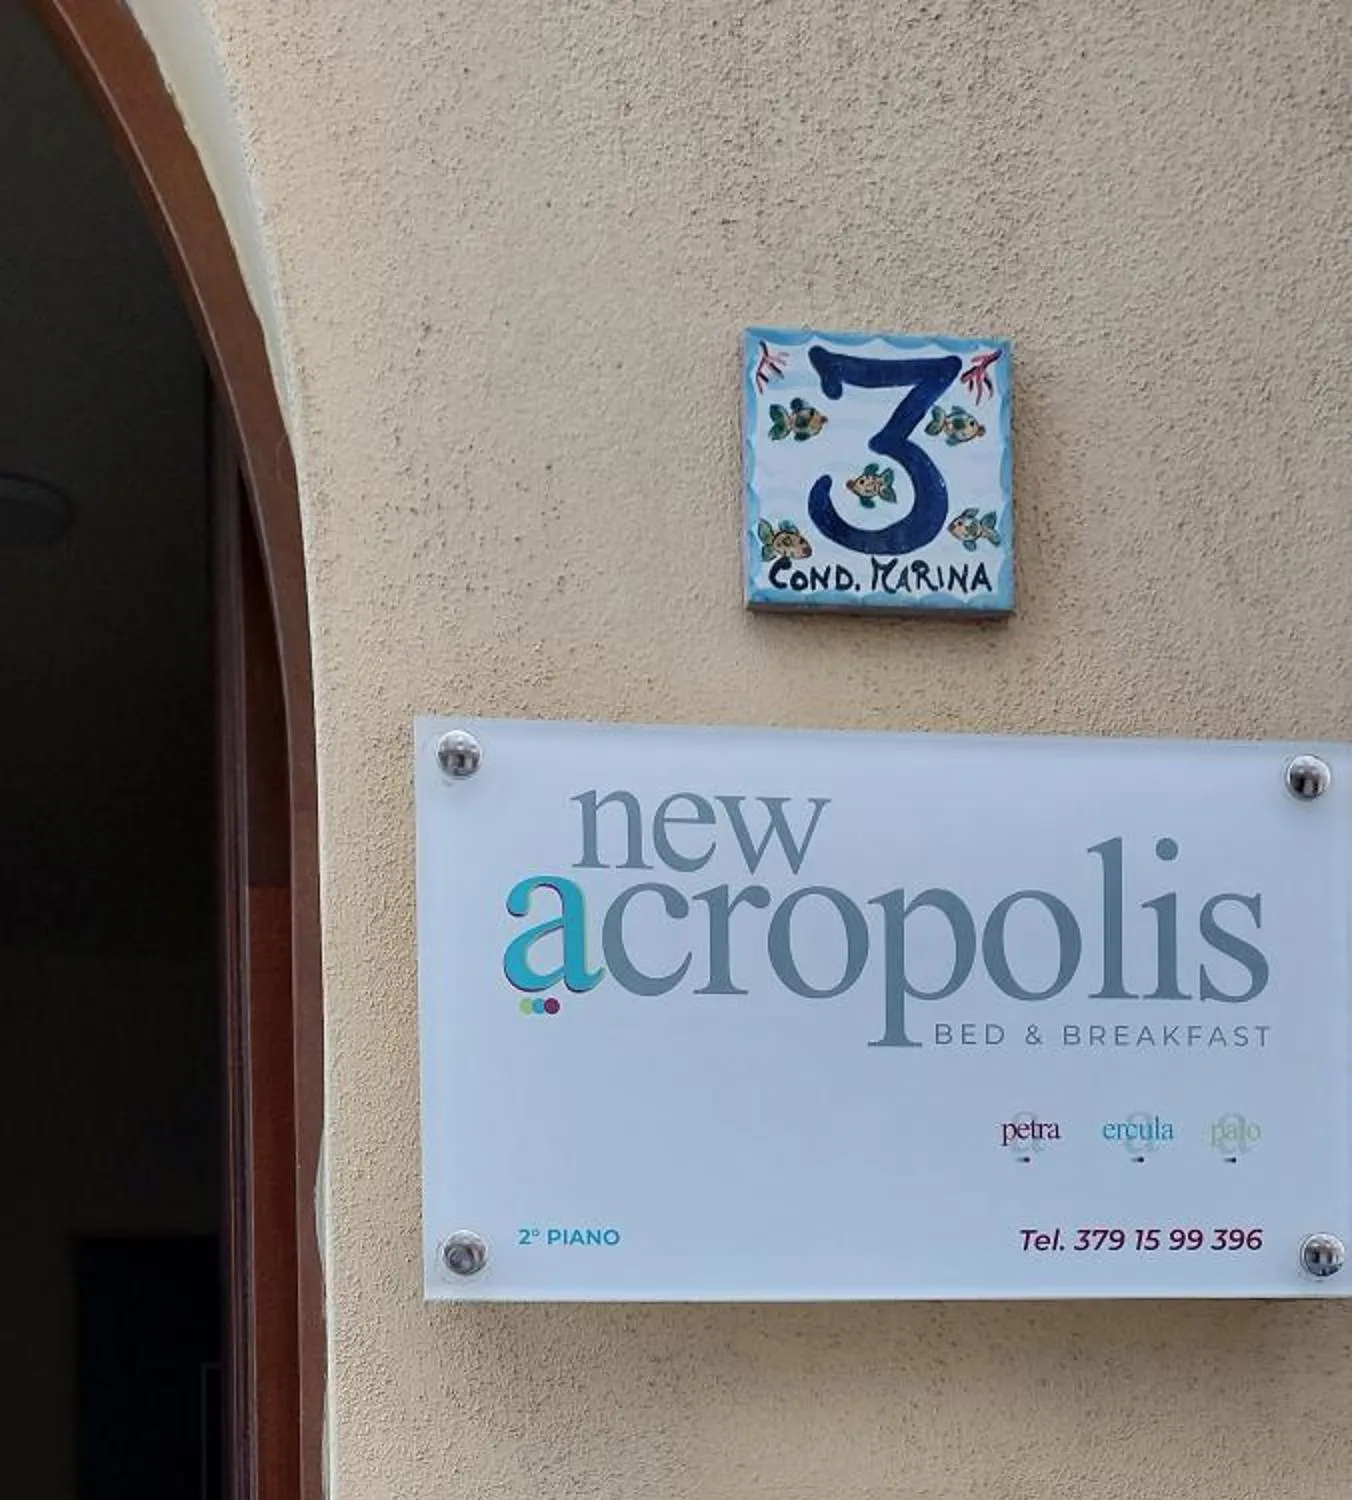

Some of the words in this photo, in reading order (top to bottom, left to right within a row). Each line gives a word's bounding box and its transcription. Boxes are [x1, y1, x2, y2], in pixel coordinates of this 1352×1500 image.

[808, 346, 962, 555] 3
[871, 556, 992, 593] MARINA
[570, 789, 831, 875] new
[502, 837, 1271, 1049] acropolis
[935, 1023, 1006, 1045] BED
[1025, 1025, 1043, 1045] &
[1063, 1025, 1271, 1047] BREAKFAST
[1002, 1118, 1061, 1146] petra
[1103, 1116, 1175, 1141] ercula
[547, 1229, 621, 1245] PIANO
[1019, 1229, 1065, 1251] Tel.
[1073, 1229, 1126, 1251] 379
[1134, 1229, 1161, 1251] 15
[1169, 1229, 1204, 1251] 99
[1210, 1229, 1264, 1251] 396
